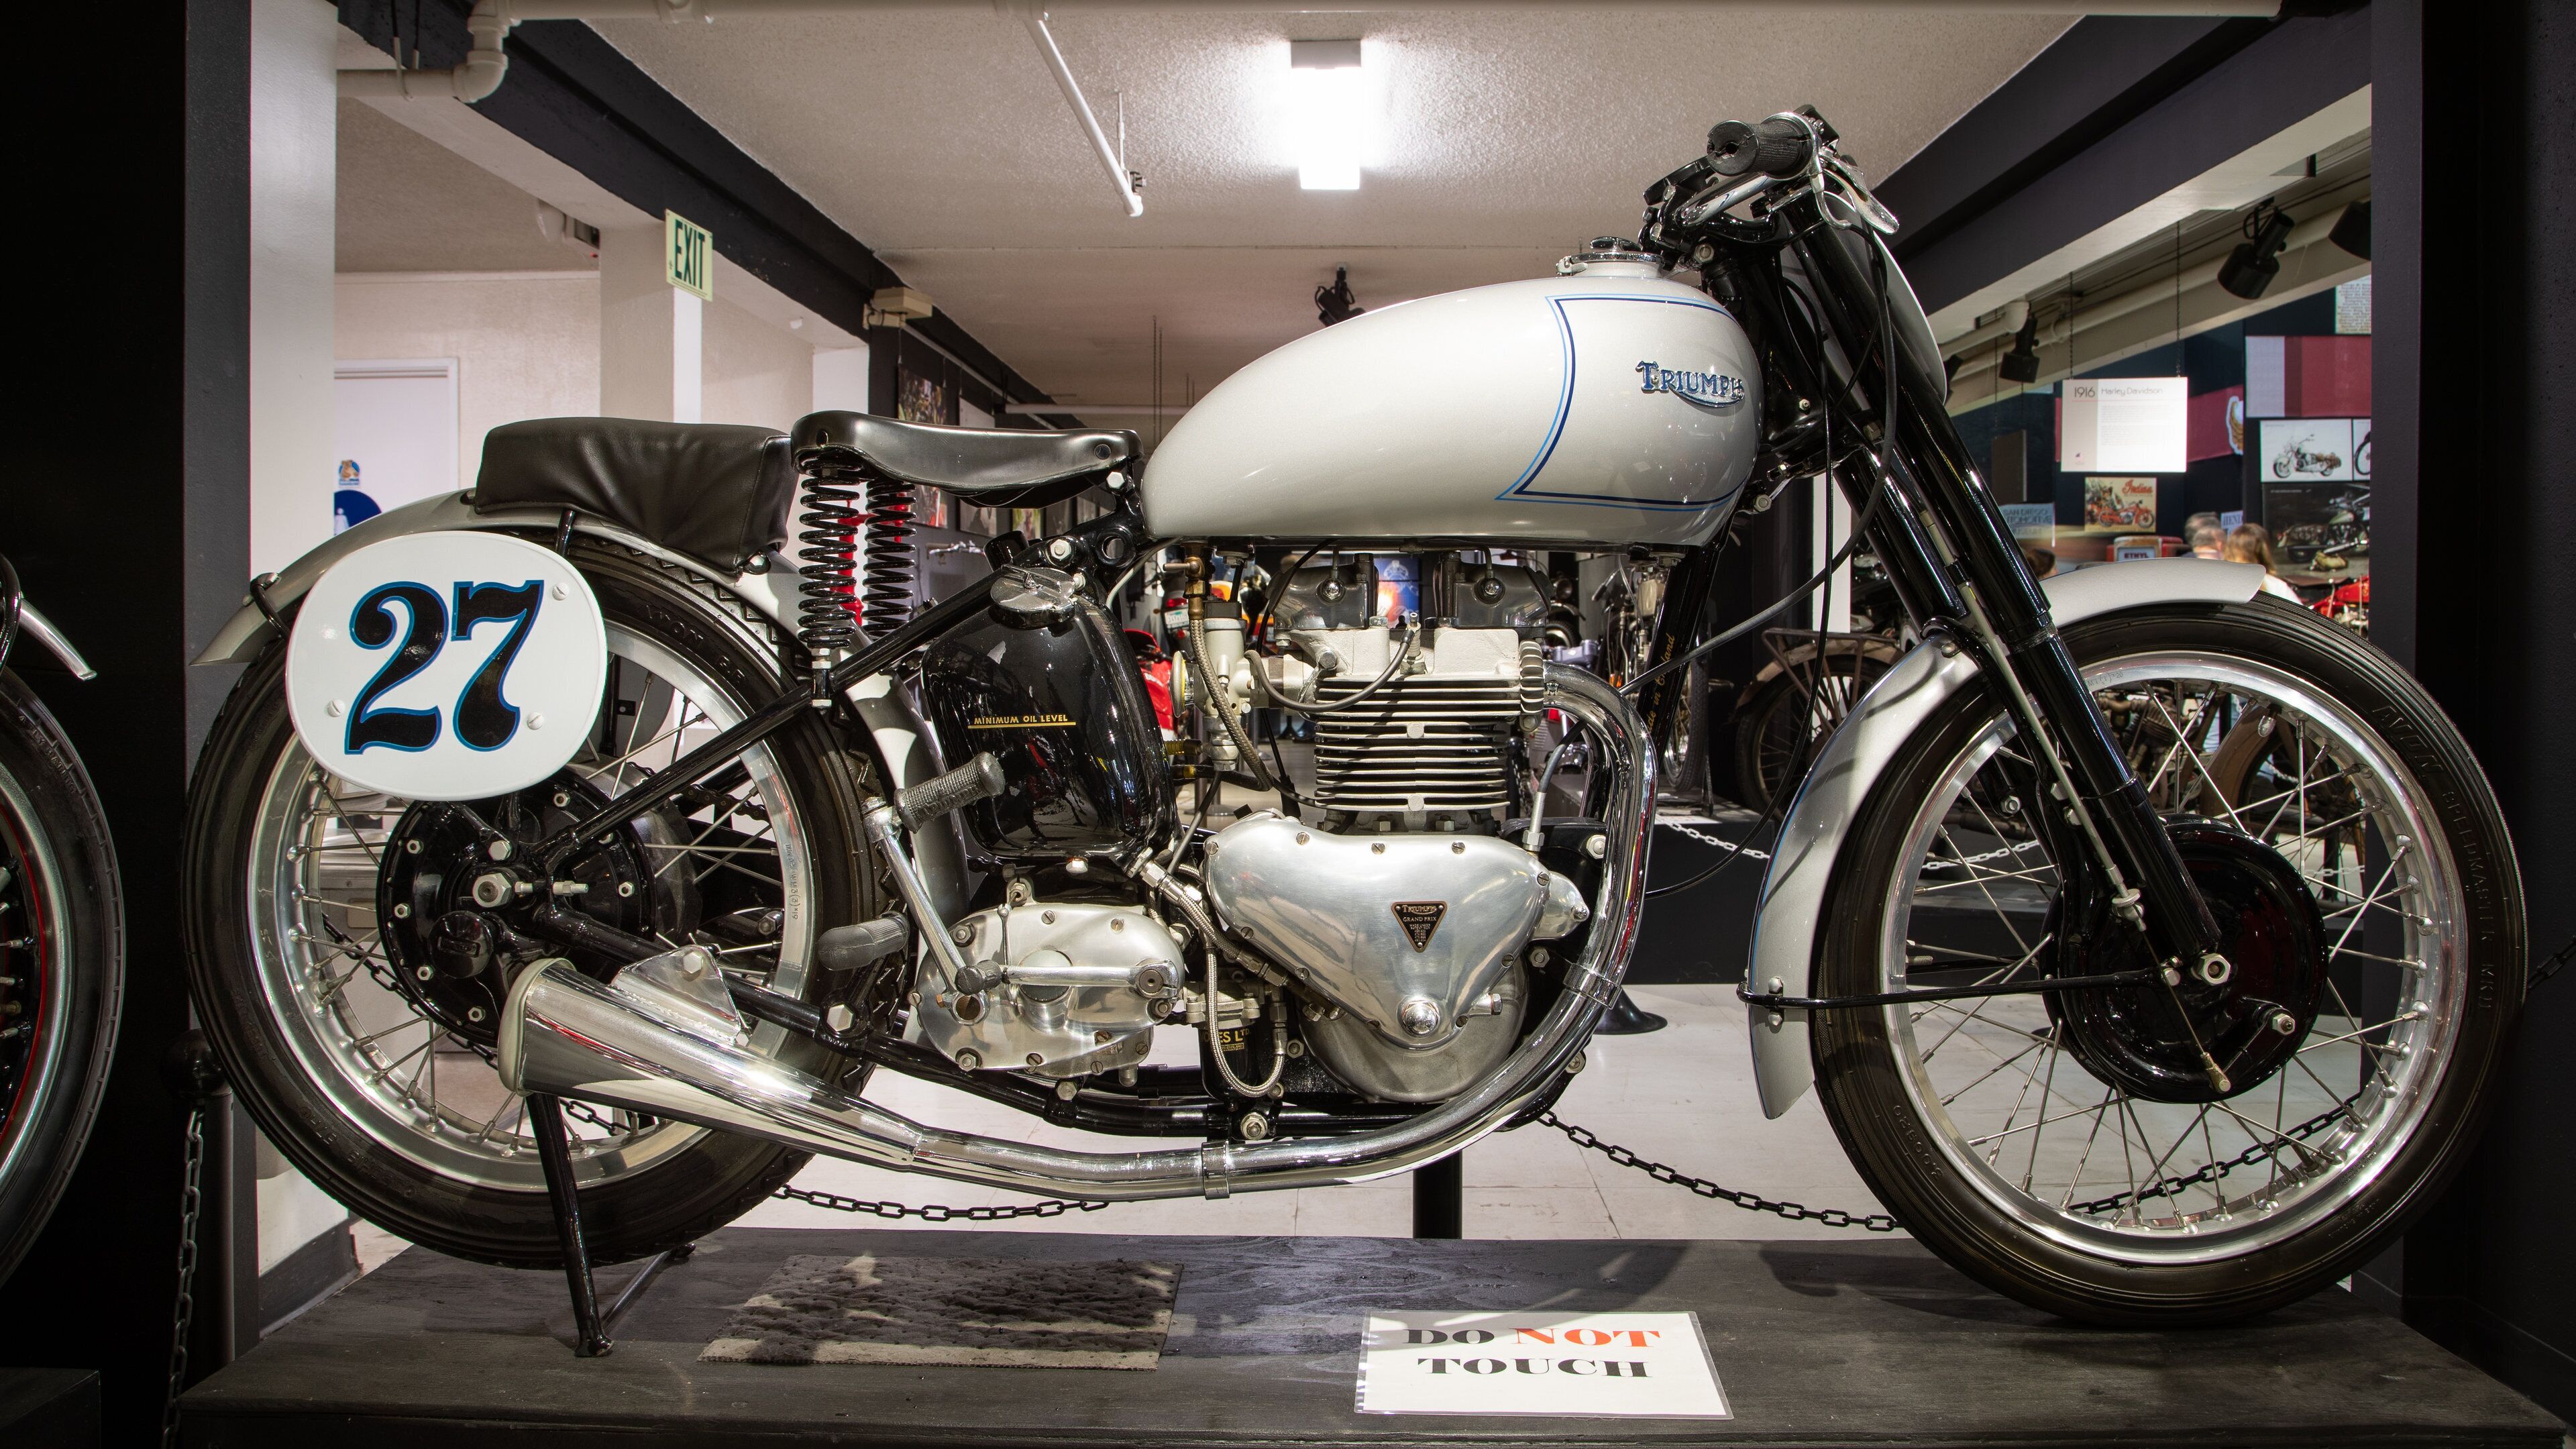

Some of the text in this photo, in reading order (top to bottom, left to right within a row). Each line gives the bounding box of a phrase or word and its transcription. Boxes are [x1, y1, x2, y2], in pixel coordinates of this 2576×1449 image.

[674, 219, 705, 290] EXIT
[1635, 360, 1744, 406] TRIUMPH
[2074, 386, 2163, 398] 1916 Harley Davidson
[2122, 480, 2153, 494] Indian
[344, 580, 544, 755] 27
[974, 716, 1019, 724] MINIMUM
[1040, 714, 1068, 722] LEVEL
[2371, 704, 2445, 773] AVON
[2440, 789, 2496, 944] SPEEDMASTER
[1402, 905, 1437, 914] TRIUMPH
[1402, 1328, 1660, 1347] DO NOT
[1417, 1358, 1653, 1378] TOUCH
